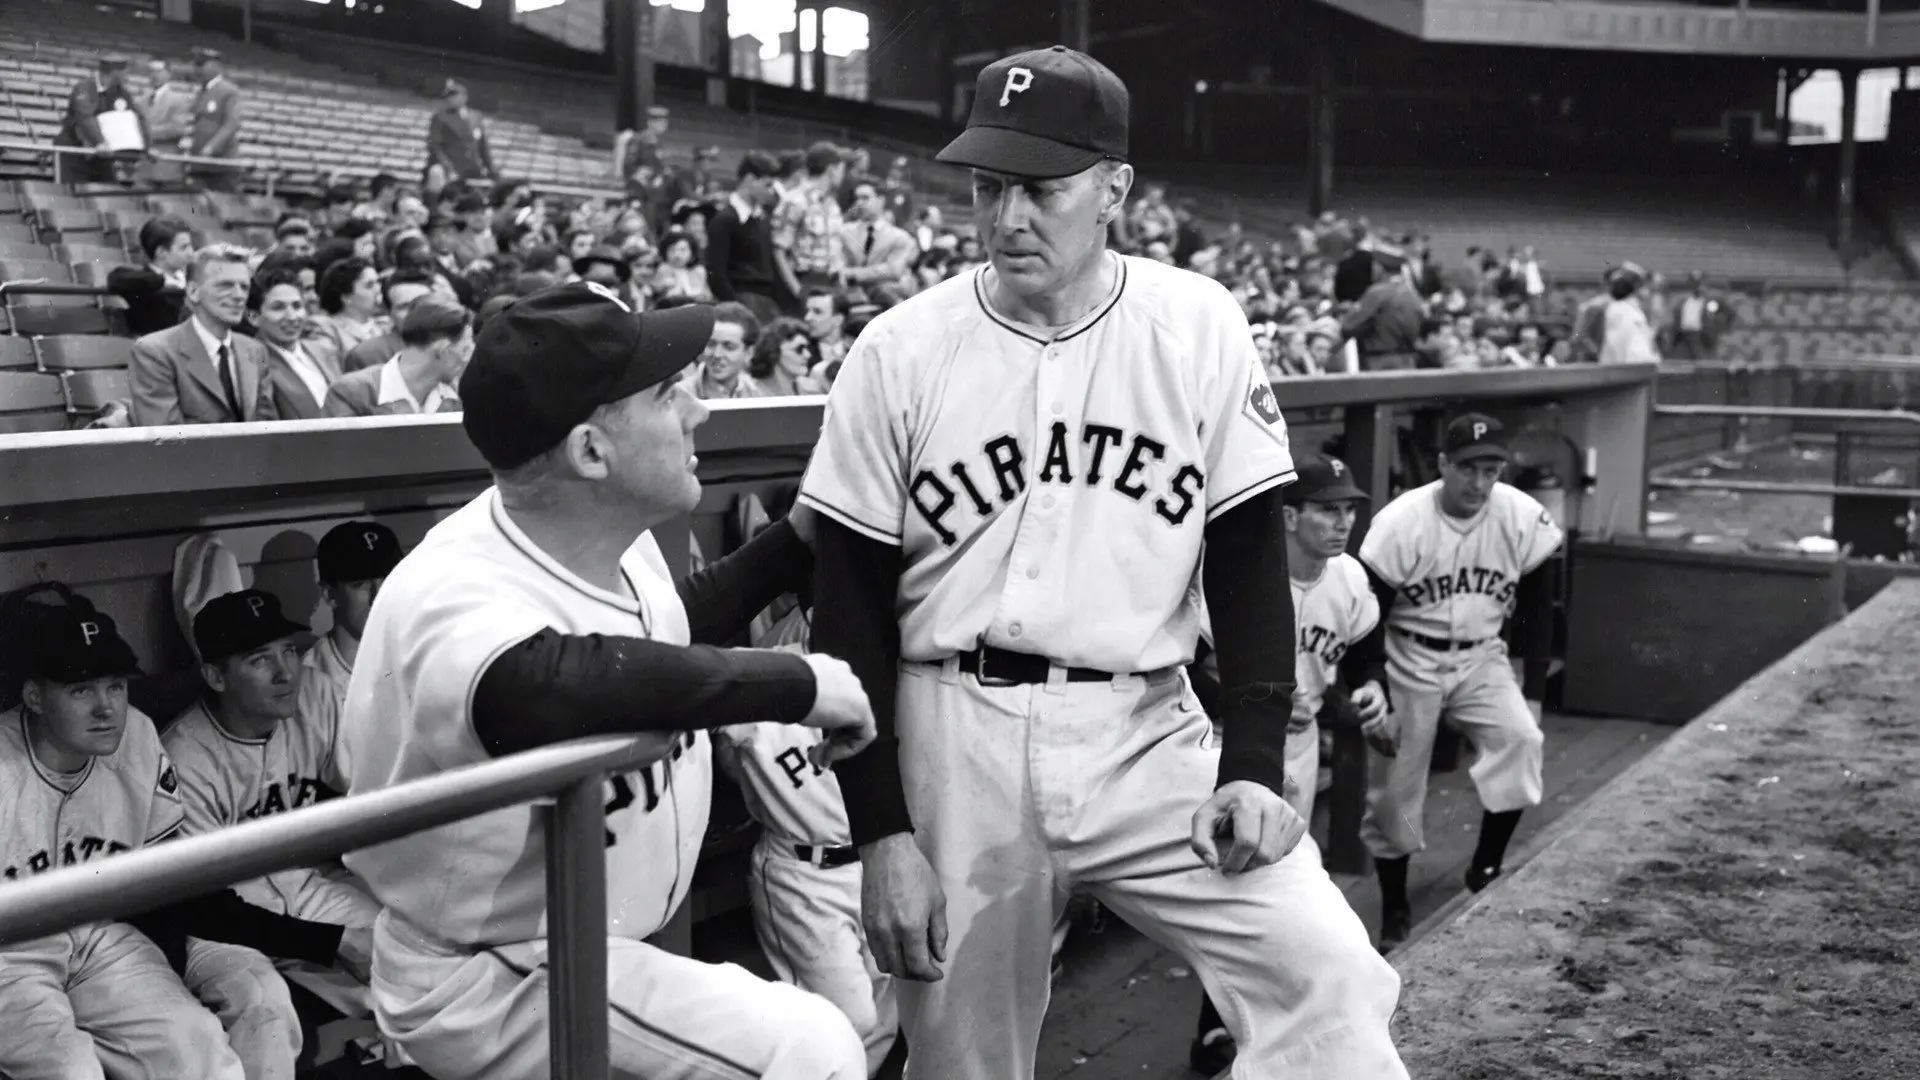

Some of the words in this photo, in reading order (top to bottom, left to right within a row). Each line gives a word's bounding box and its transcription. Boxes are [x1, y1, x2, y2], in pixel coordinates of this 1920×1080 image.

[1000, 67, 1034, 107] P
[1473, 422, 1488, 440] P
[1331, 459, 1345, 478] P
[909, 421, 1205, 546] PIRATES
[363, 531, 379, 550] P
[1402, 566, 1517, 607] PIRATES
[248, 596, 265, 617] P
[81, 621, 100, 645] P
